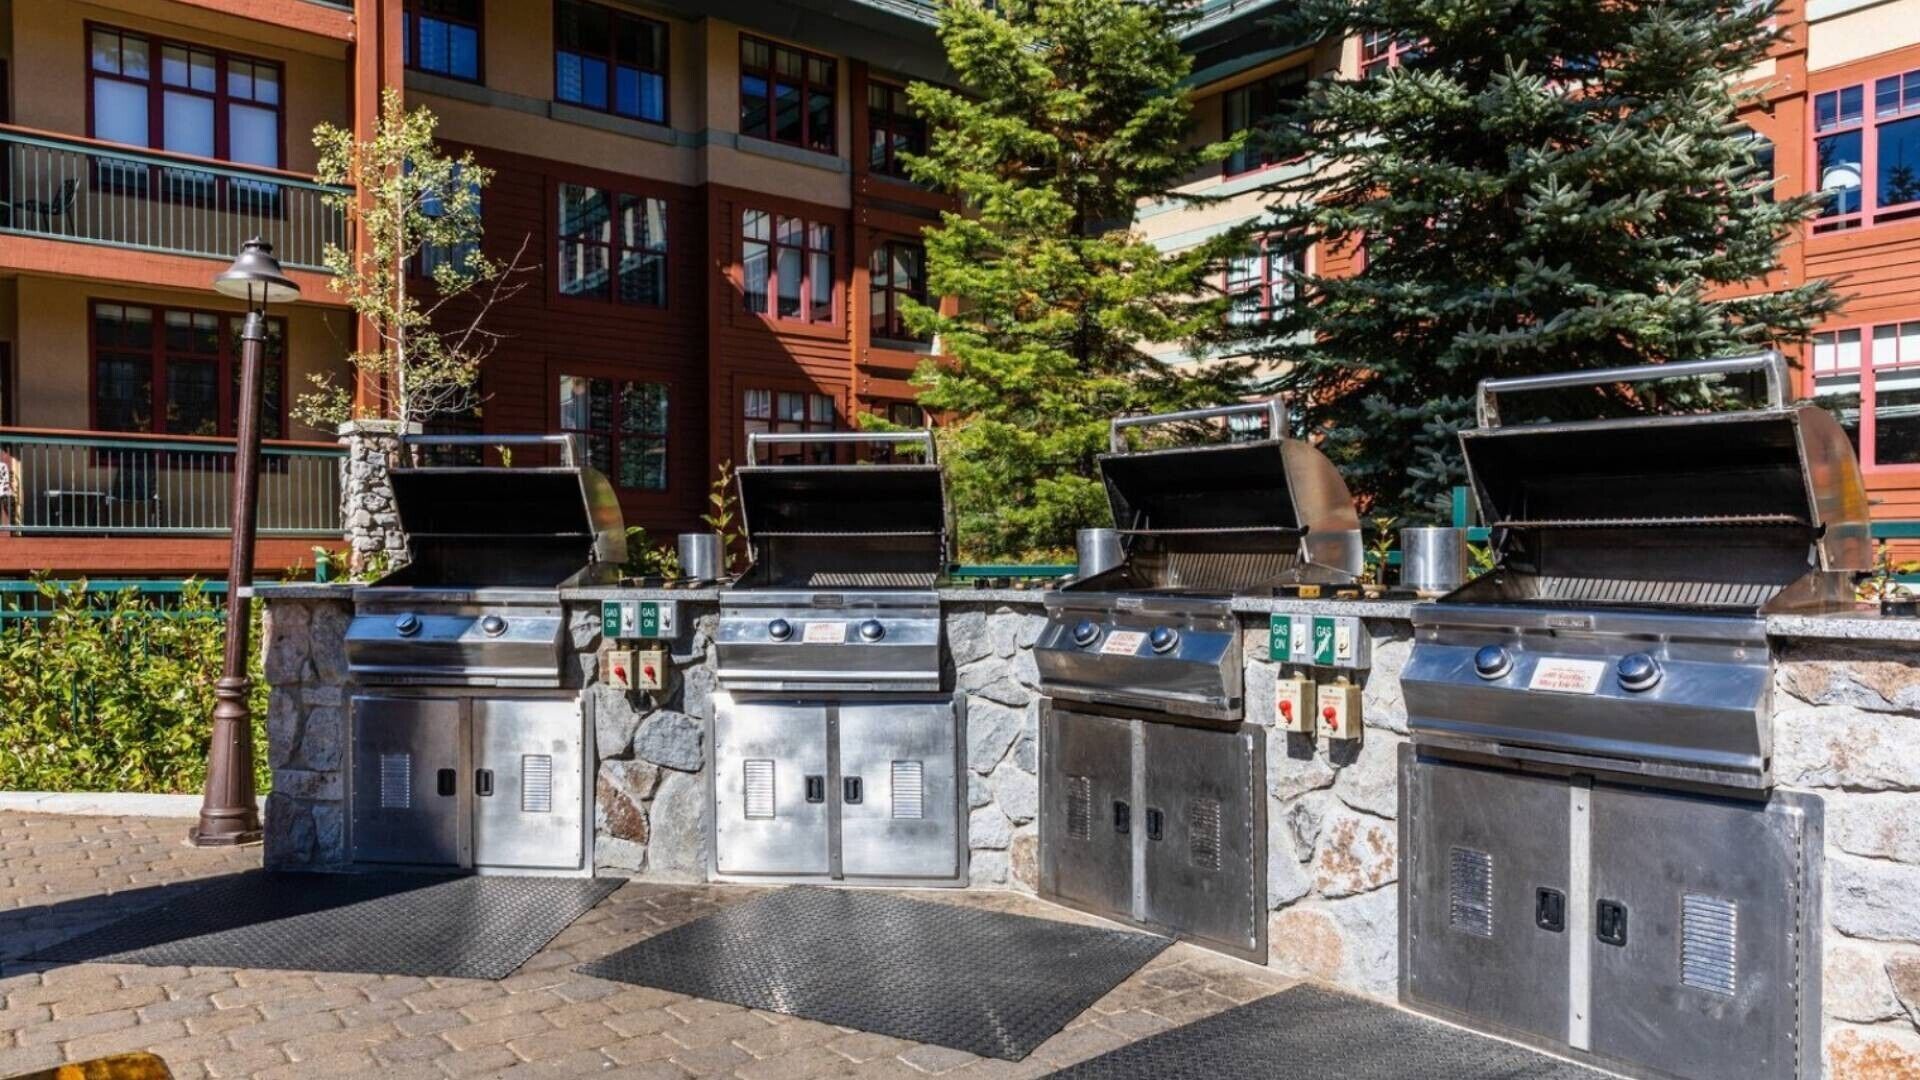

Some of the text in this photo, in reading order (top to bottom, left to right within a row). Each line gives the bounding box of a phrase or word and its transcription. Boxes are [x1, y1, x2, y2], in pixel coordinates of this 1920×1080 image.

[604, 607, 618, 618] GAS
[642, 607, 656, 618] GAS
[607, 619, 617, 628] ON
[643, 619, 654, 628] ON
[1273, 623, 1288, 636] GAS
[1316, 625, 1332, 638] GAS
[1274, 637, 1286, 649] ON
